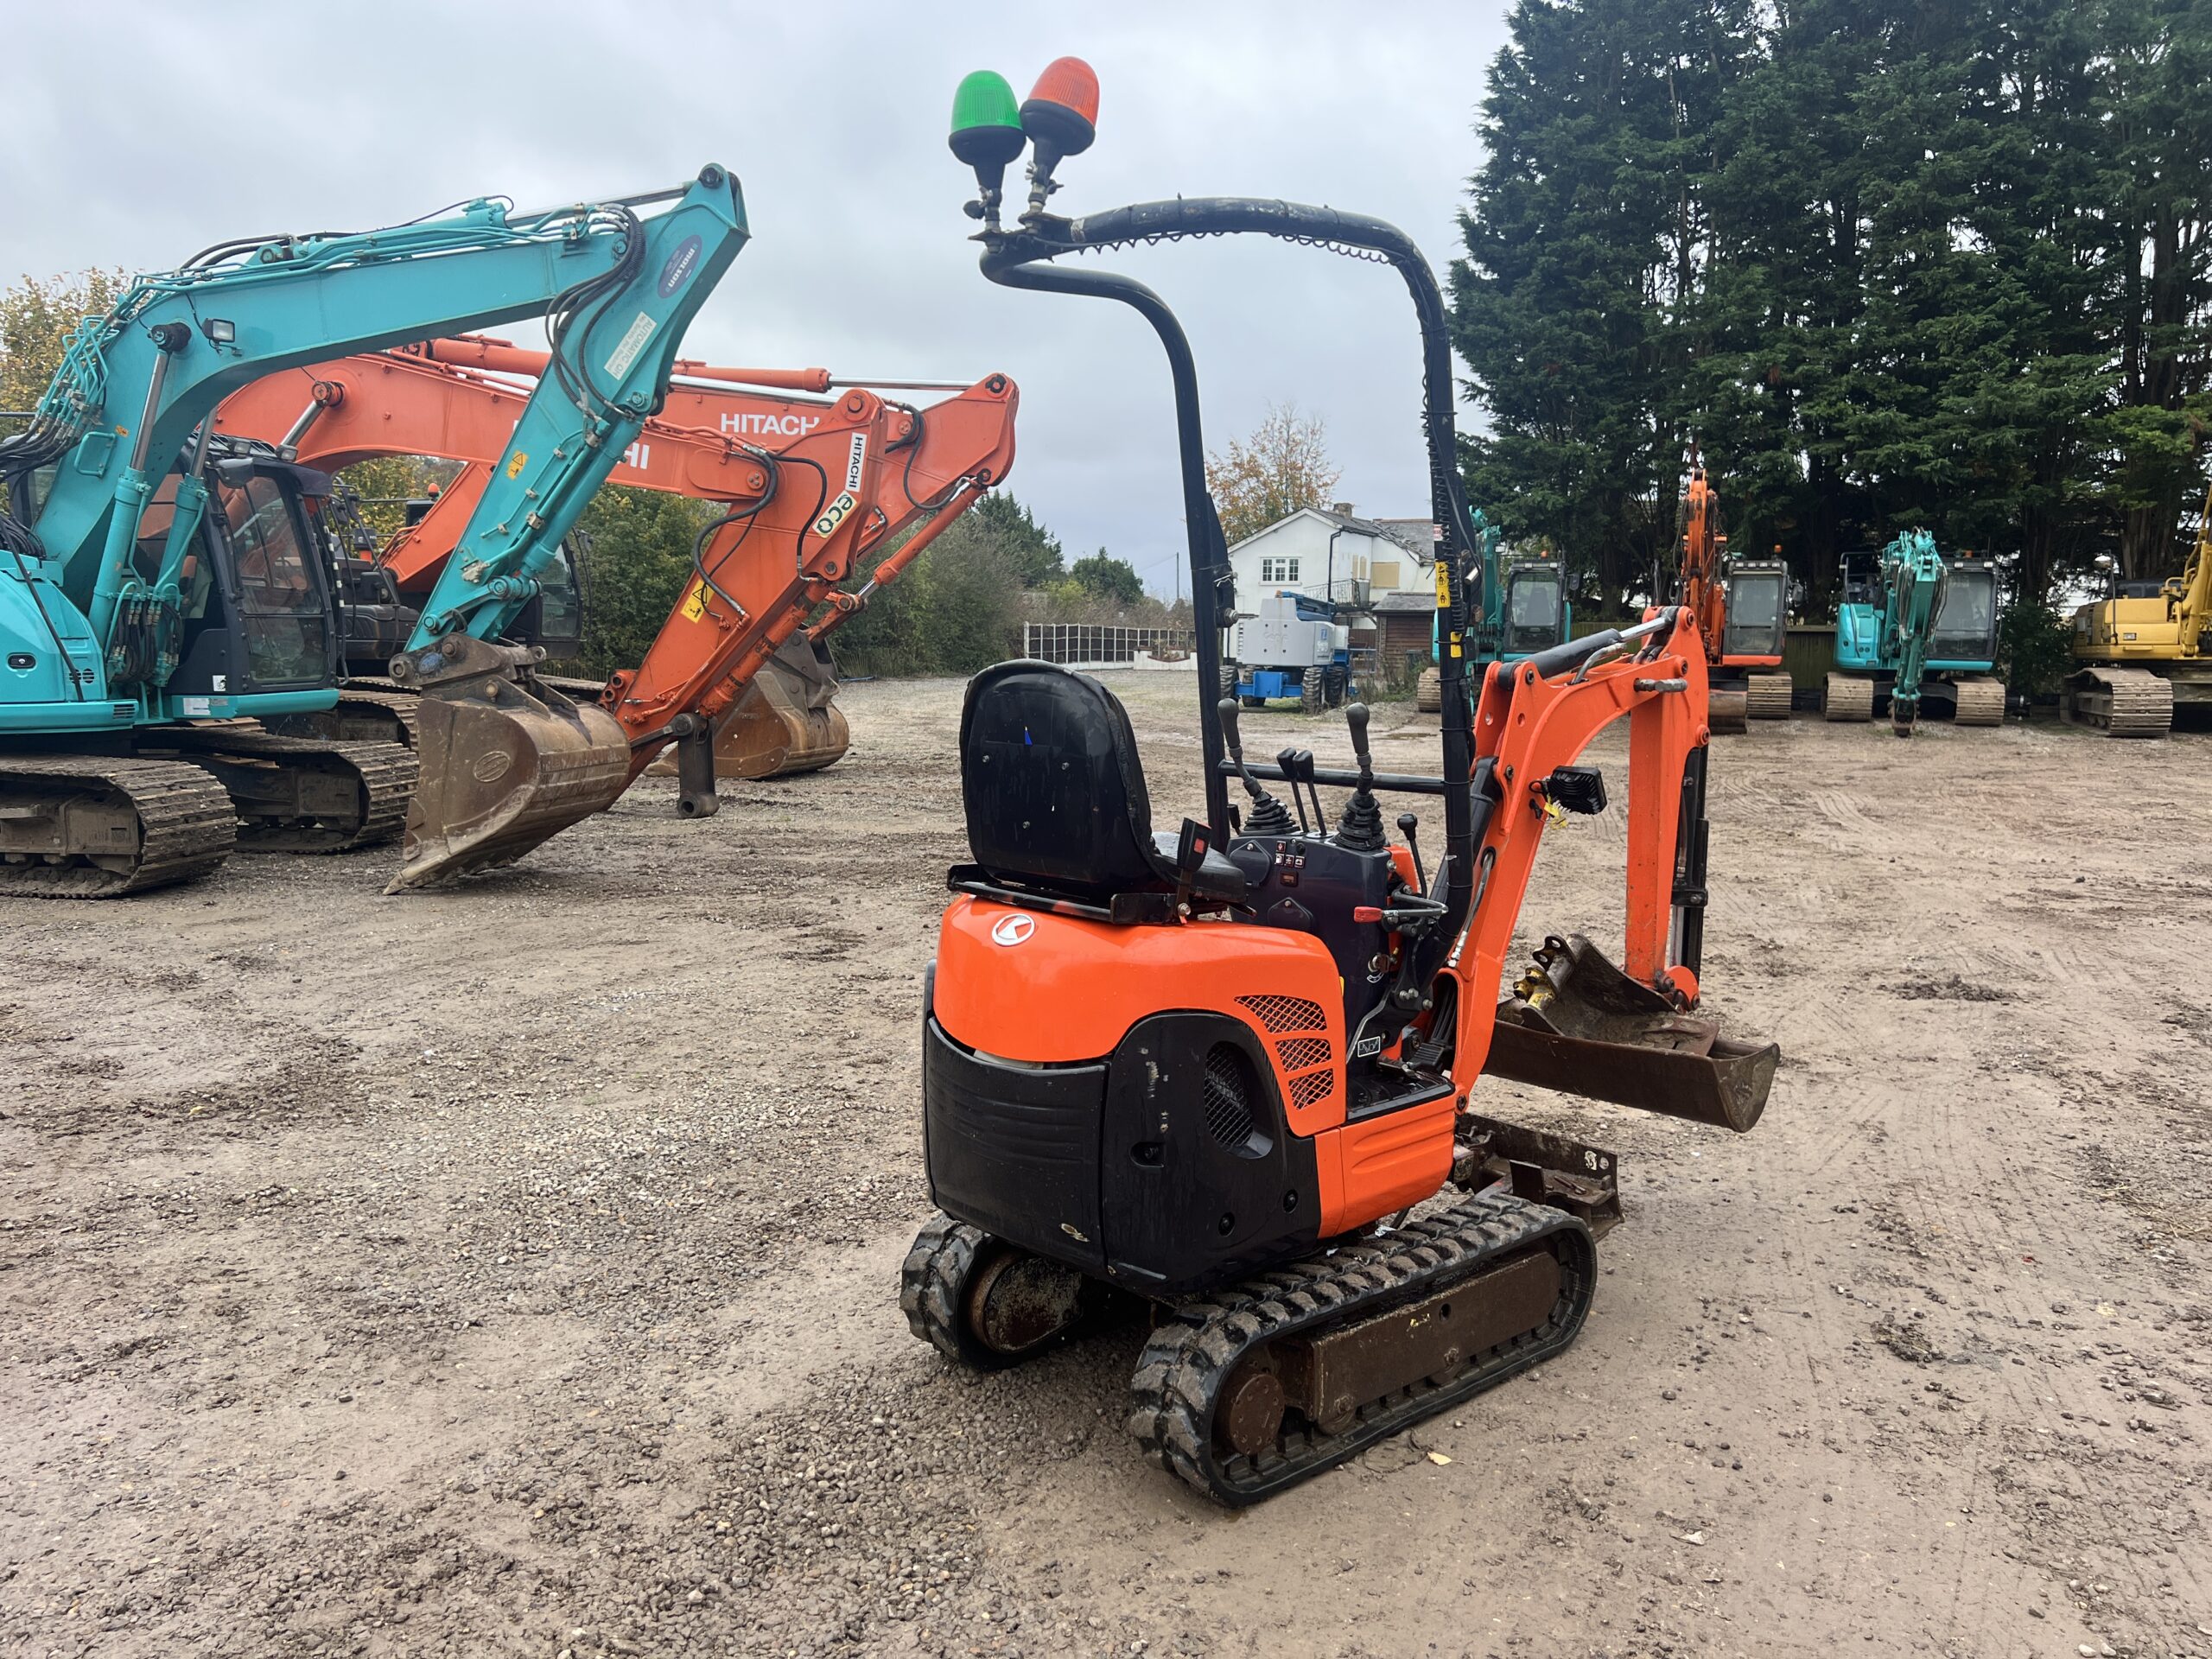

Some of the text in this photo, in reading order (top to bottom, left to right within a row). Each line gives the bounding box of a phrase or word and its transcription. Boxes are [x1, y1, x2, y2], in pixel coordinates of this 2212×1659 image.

[621, 320, 653, 364] AUTOMATIC
[721, 413, 820, 435] HITACH
[849, 436, 863, 488] HITACHI
[817, 495, 853, 534] eco
